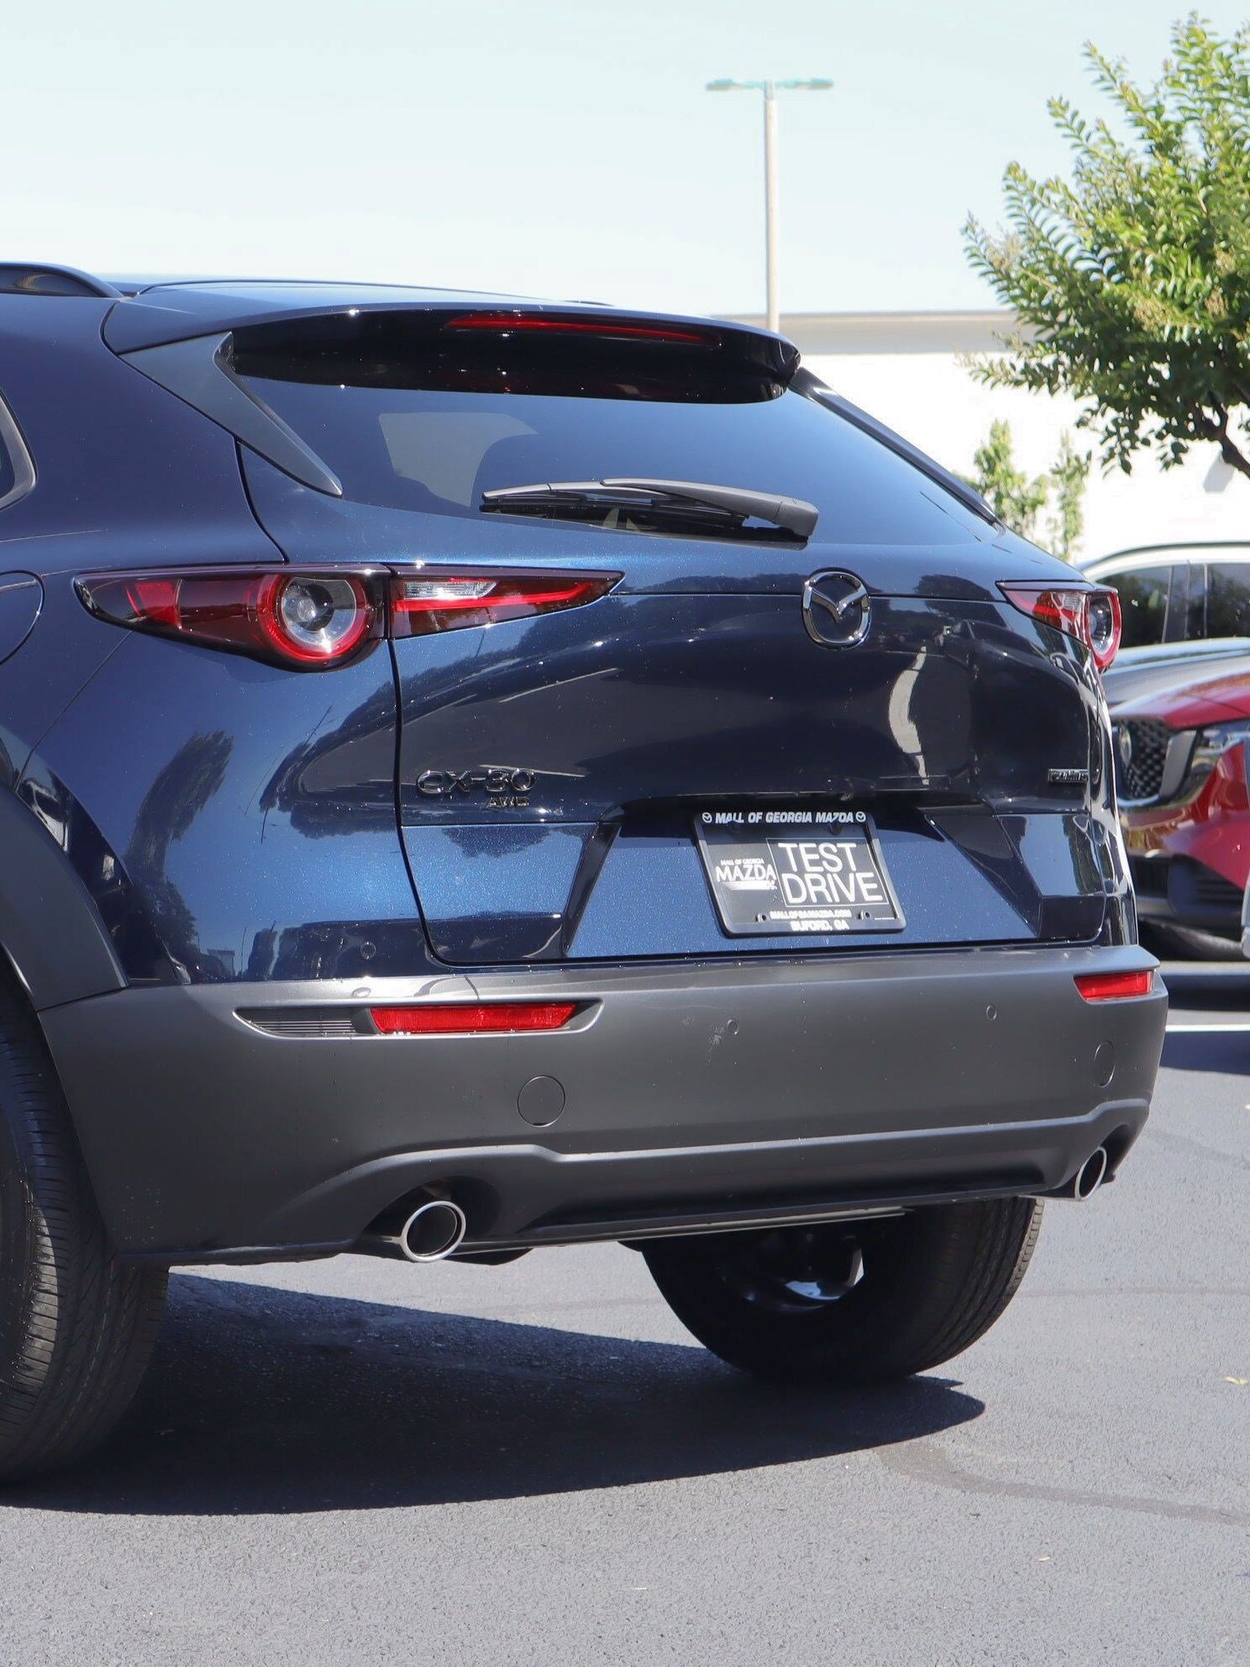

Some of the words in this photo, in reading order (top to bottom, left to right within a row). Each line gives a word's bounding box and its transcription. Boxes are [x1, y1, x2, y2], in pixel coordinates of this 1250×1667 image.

[416, 768, 534, 794] CX-30
[715, 812, 744, 824] MALL
[748, 812, 763, 824] OF
[765, 811, 813, 824] GEORGIA
[815, 811, 854, 824] MAZDA
[777, 842, 857, 872] TEST
[715, 864, 777, 883] MAZDA
[781, 872, 884, 903] DRIVE
